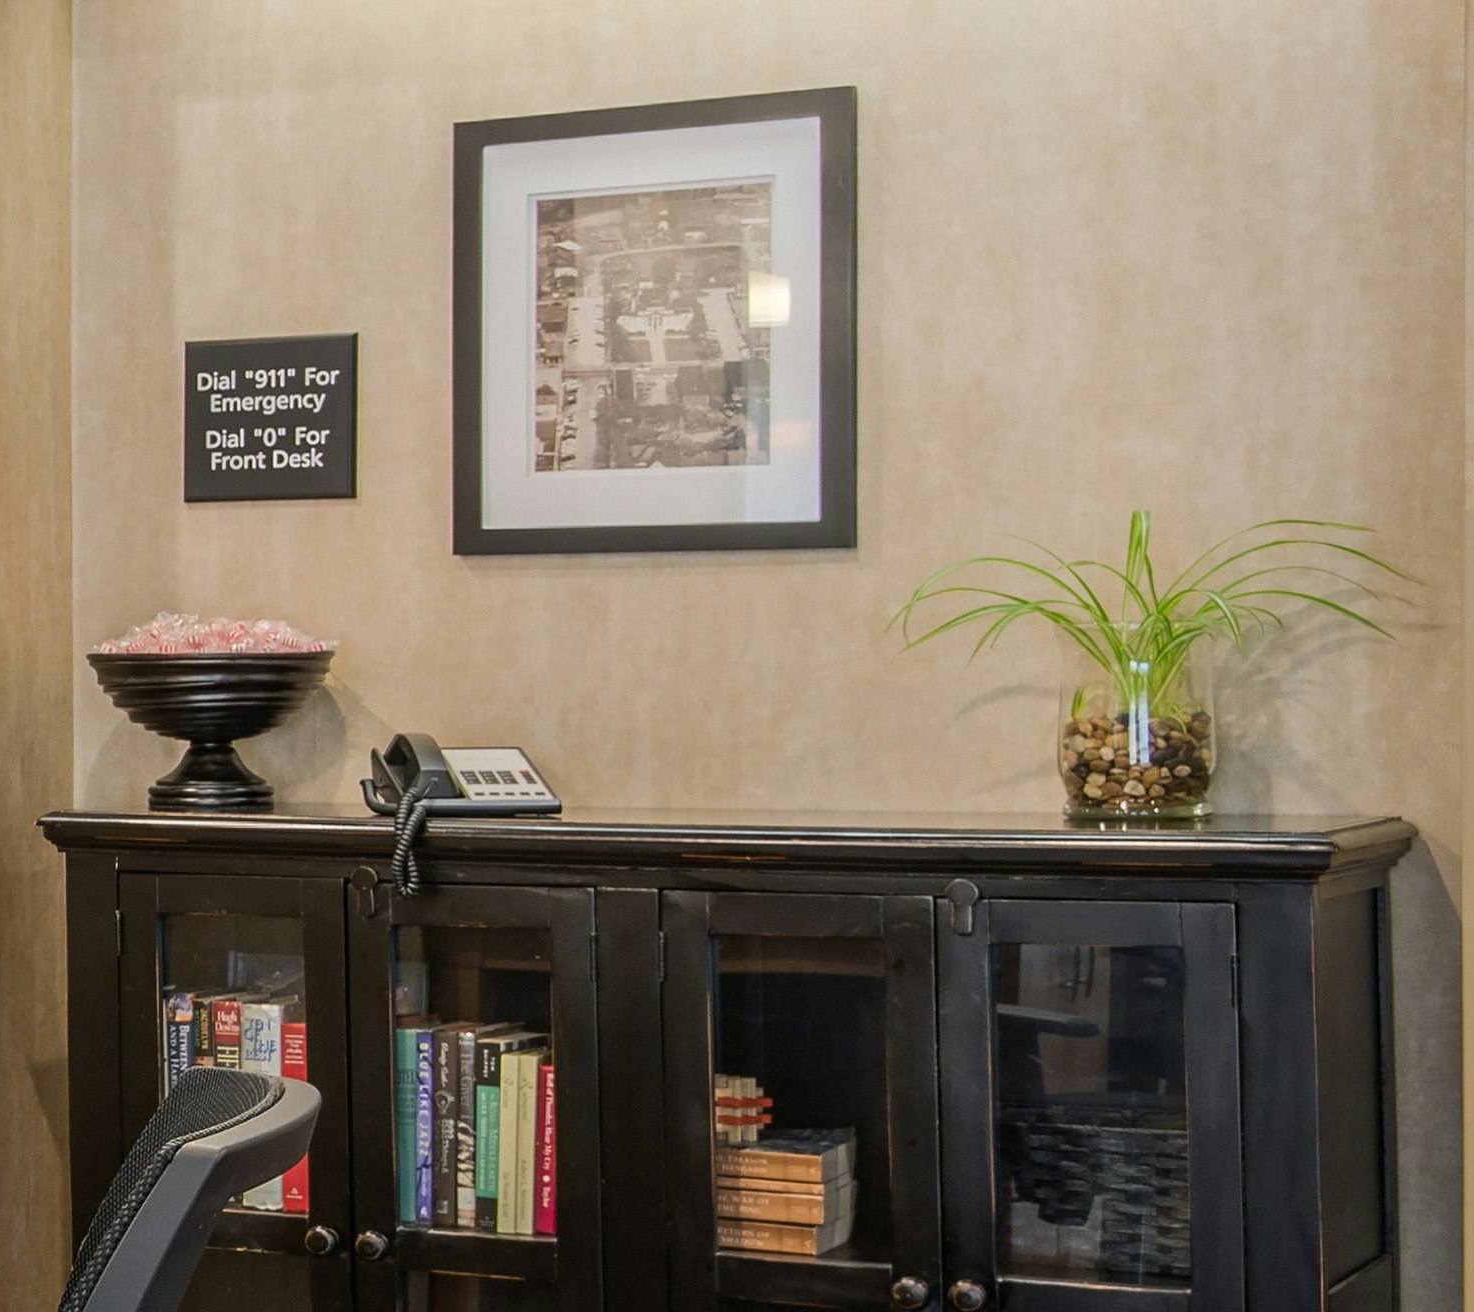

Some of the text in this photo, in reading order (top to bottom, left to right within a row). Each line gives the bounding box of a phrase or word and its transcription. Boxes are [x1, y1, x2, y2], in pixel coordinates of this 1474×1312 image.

[197, 367, 340, 391] Dial "911" For
[210, 393, 326, 415] Emergency
[205, 426, 330, 449] Dial "0" For
[211, 448, 324, 471] Front Desk
[217, 1010, 237, 1023] Hugh
[179, 1025, 190, 1071] BETWEEN
[418, 1042, 429, 1080] BLUE
[545, 1073, 554, 1087] Roll
[419, 1085, 429, 1117] LIKE
[460, 1076, 474, 1108] Giver
[545, 1087, 553, 1096] of
[418, 1122, 429, 1157] JAZZ
[544, 1127, 553, 1144] Hear
[543, 1144, 552, 1156] My
[542, 1156, 551, 1170] Cry
[541, 1186, 551, 1208] Taylor
